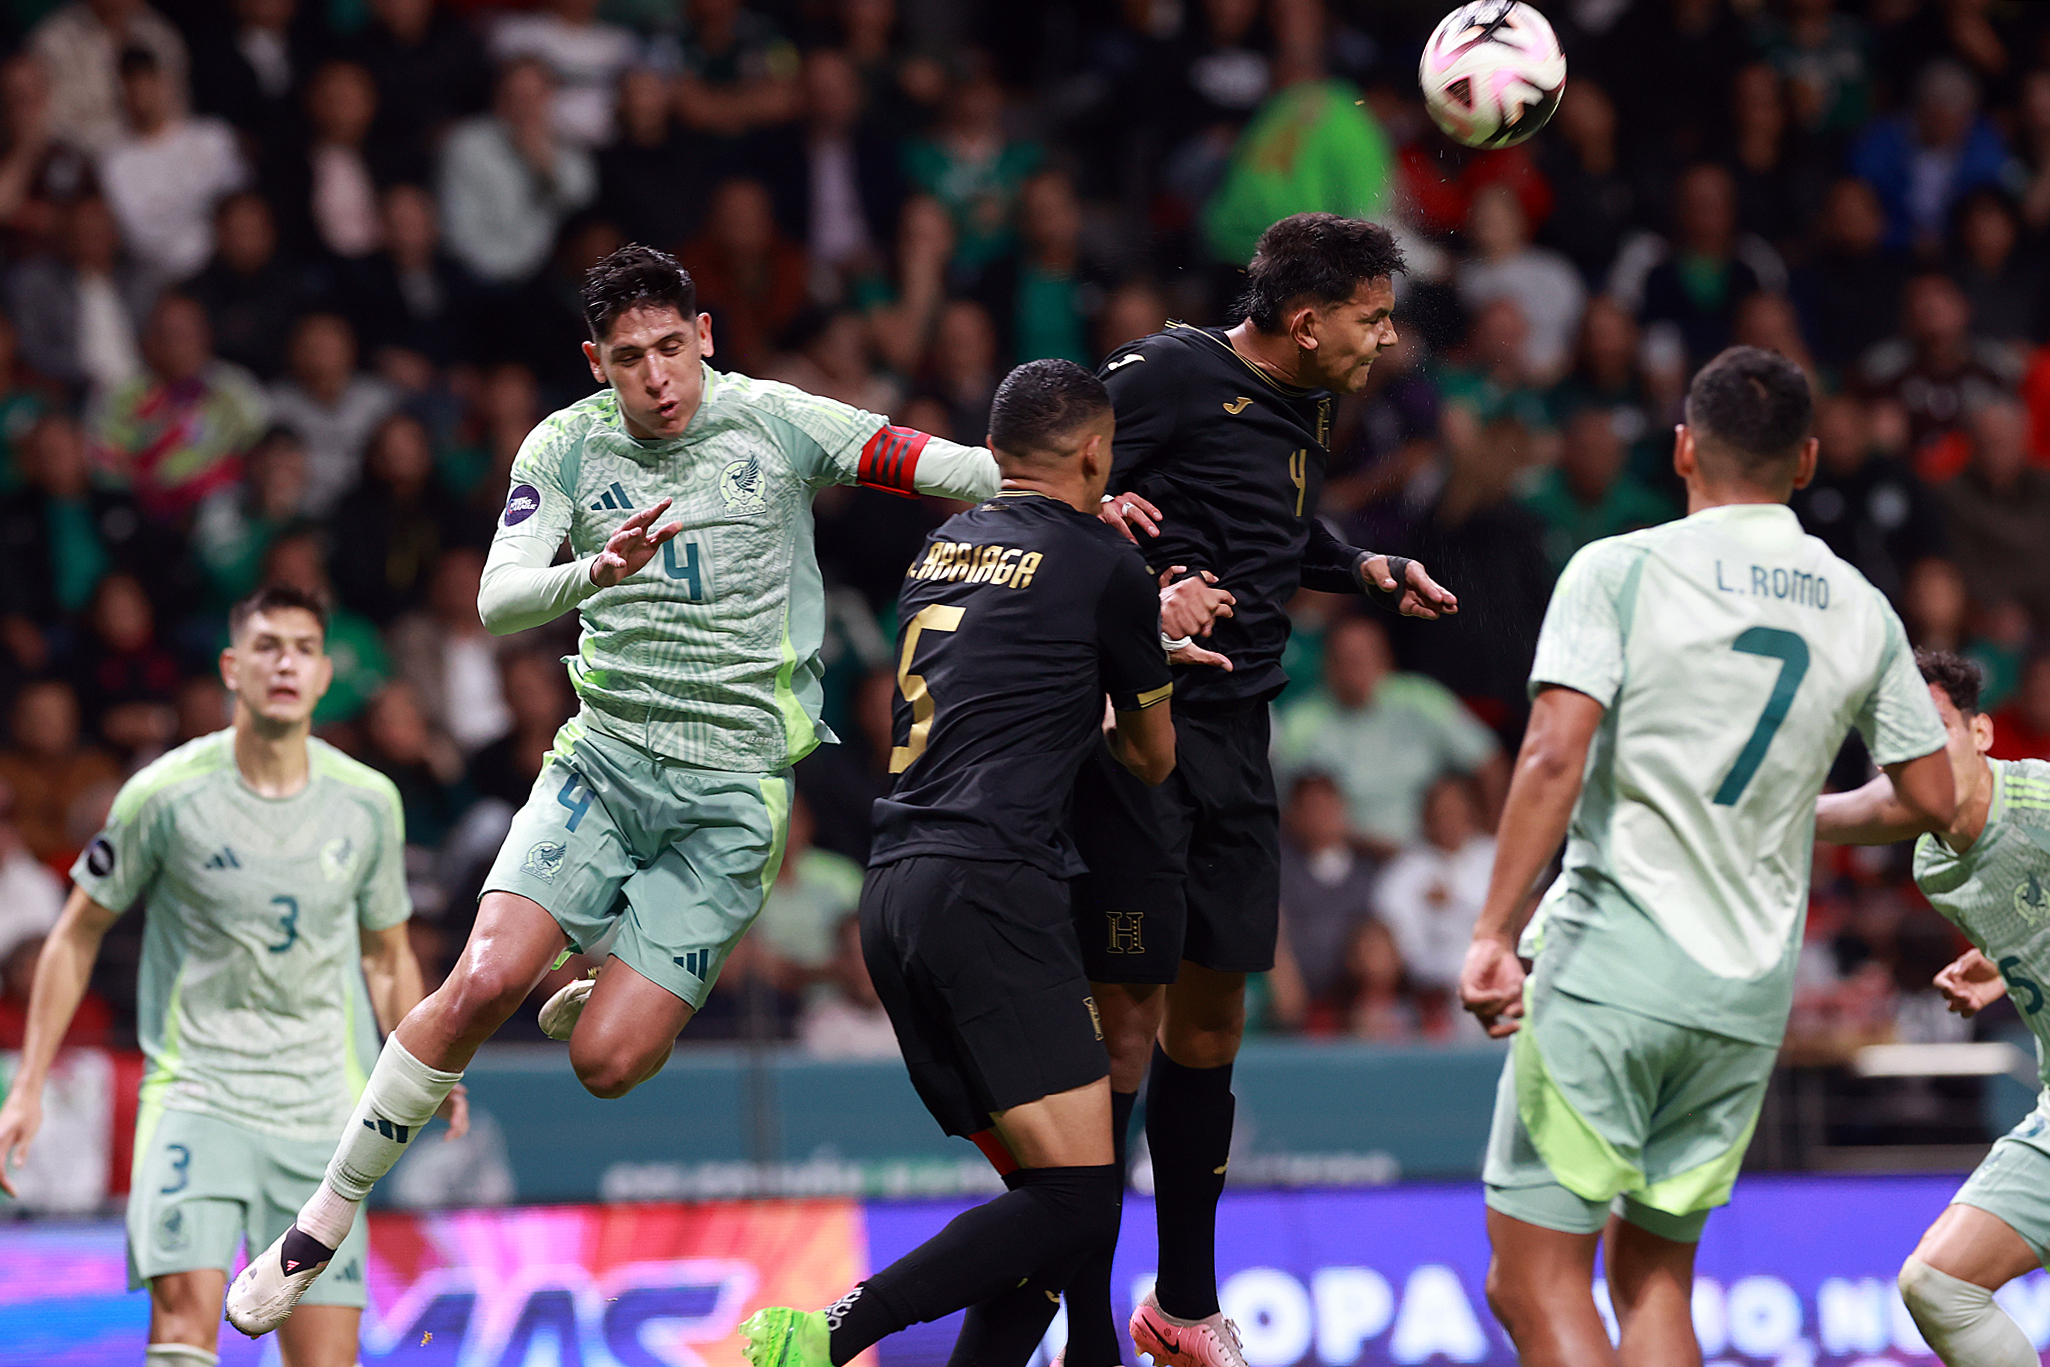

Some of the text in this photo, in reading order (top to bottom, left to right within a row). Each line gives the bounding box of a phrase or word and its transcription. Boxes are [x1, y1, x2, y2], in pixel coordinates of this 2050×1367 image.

[1289, 448, 1308, 518] 4
[663, 536, 702, 601] 4
[1715, 559, 1830, 611] L.ROMO
[888, 603, 967, 774] 5
[1712, 626, 1811, 808] 7
[556, 771, 597, 834] 4
[267, 895, 300, 954] 3
[2000, 955, 2045, 1016] 5
[159, 1143, 190, 1195] 3
[1131, 1264, 1491, 1367] OPA
